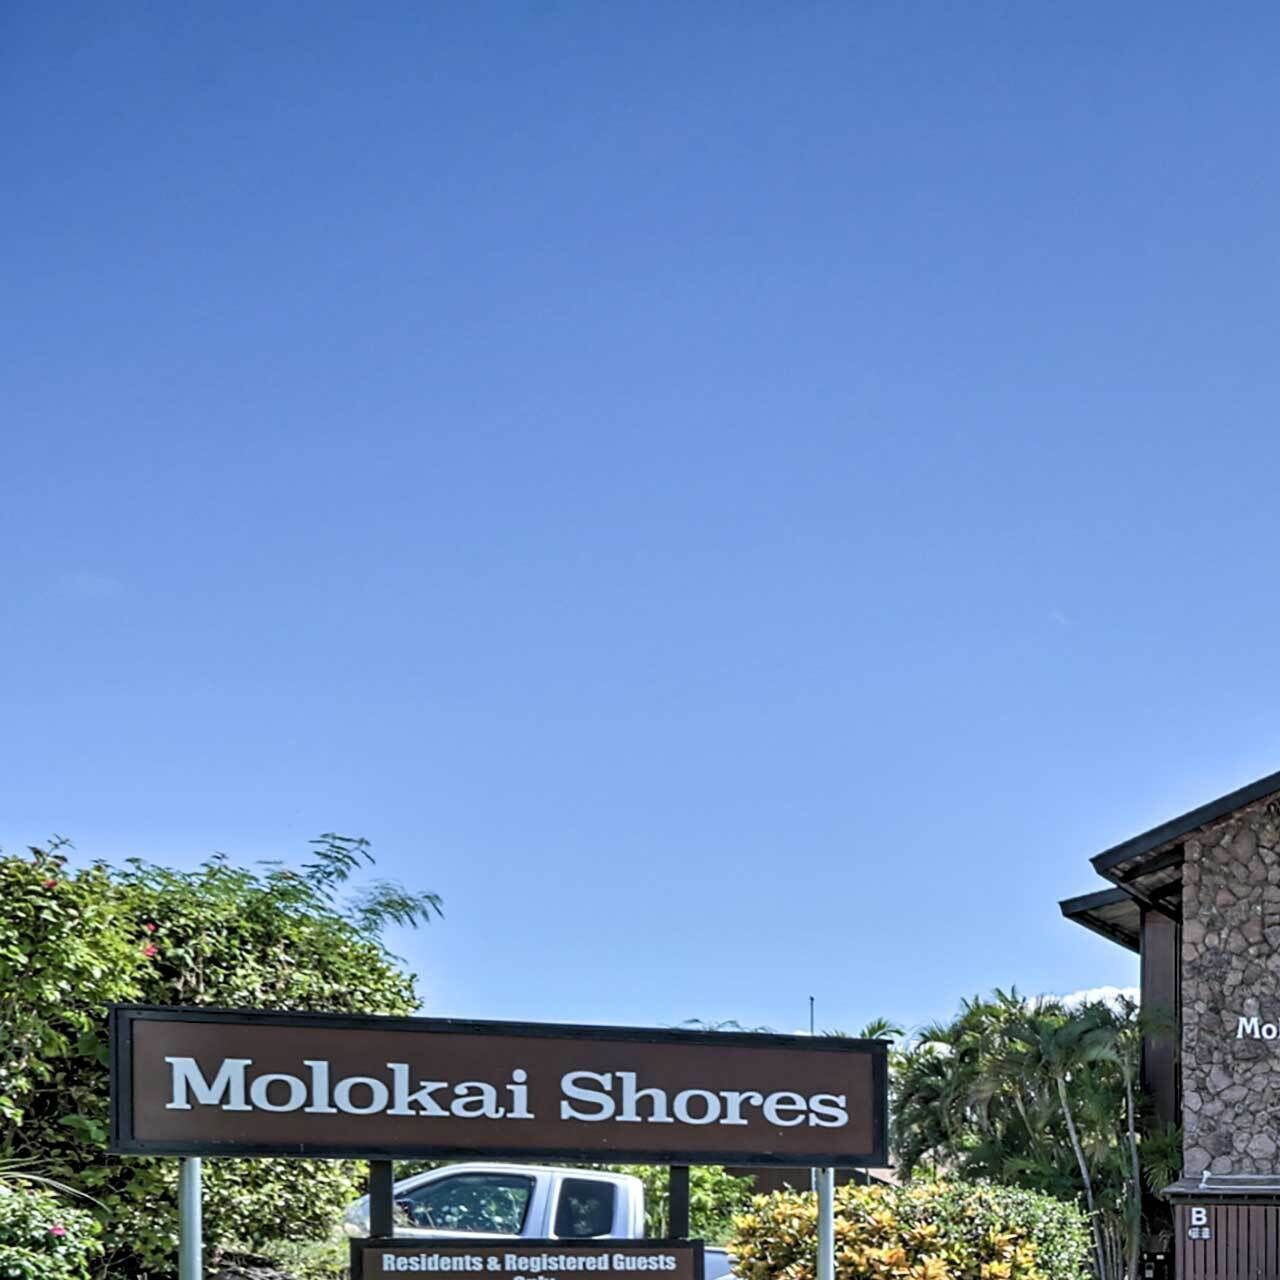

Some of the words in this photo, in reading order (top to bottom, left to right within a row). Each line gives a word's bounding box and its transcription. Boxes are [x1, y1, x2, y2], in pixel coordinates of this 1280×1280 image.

[165, 1056, 535, 1119] Molokai
[560, 1070, 849, 1128] Shores
[1191, 1207, 1207, 1225] B
[382, 1254, 484, 1272] Residents
[486, 1256, 502, 1271] &
[504, 1254, 610, 1273] Registered
[612, 1253, 677, 1271] Guests
